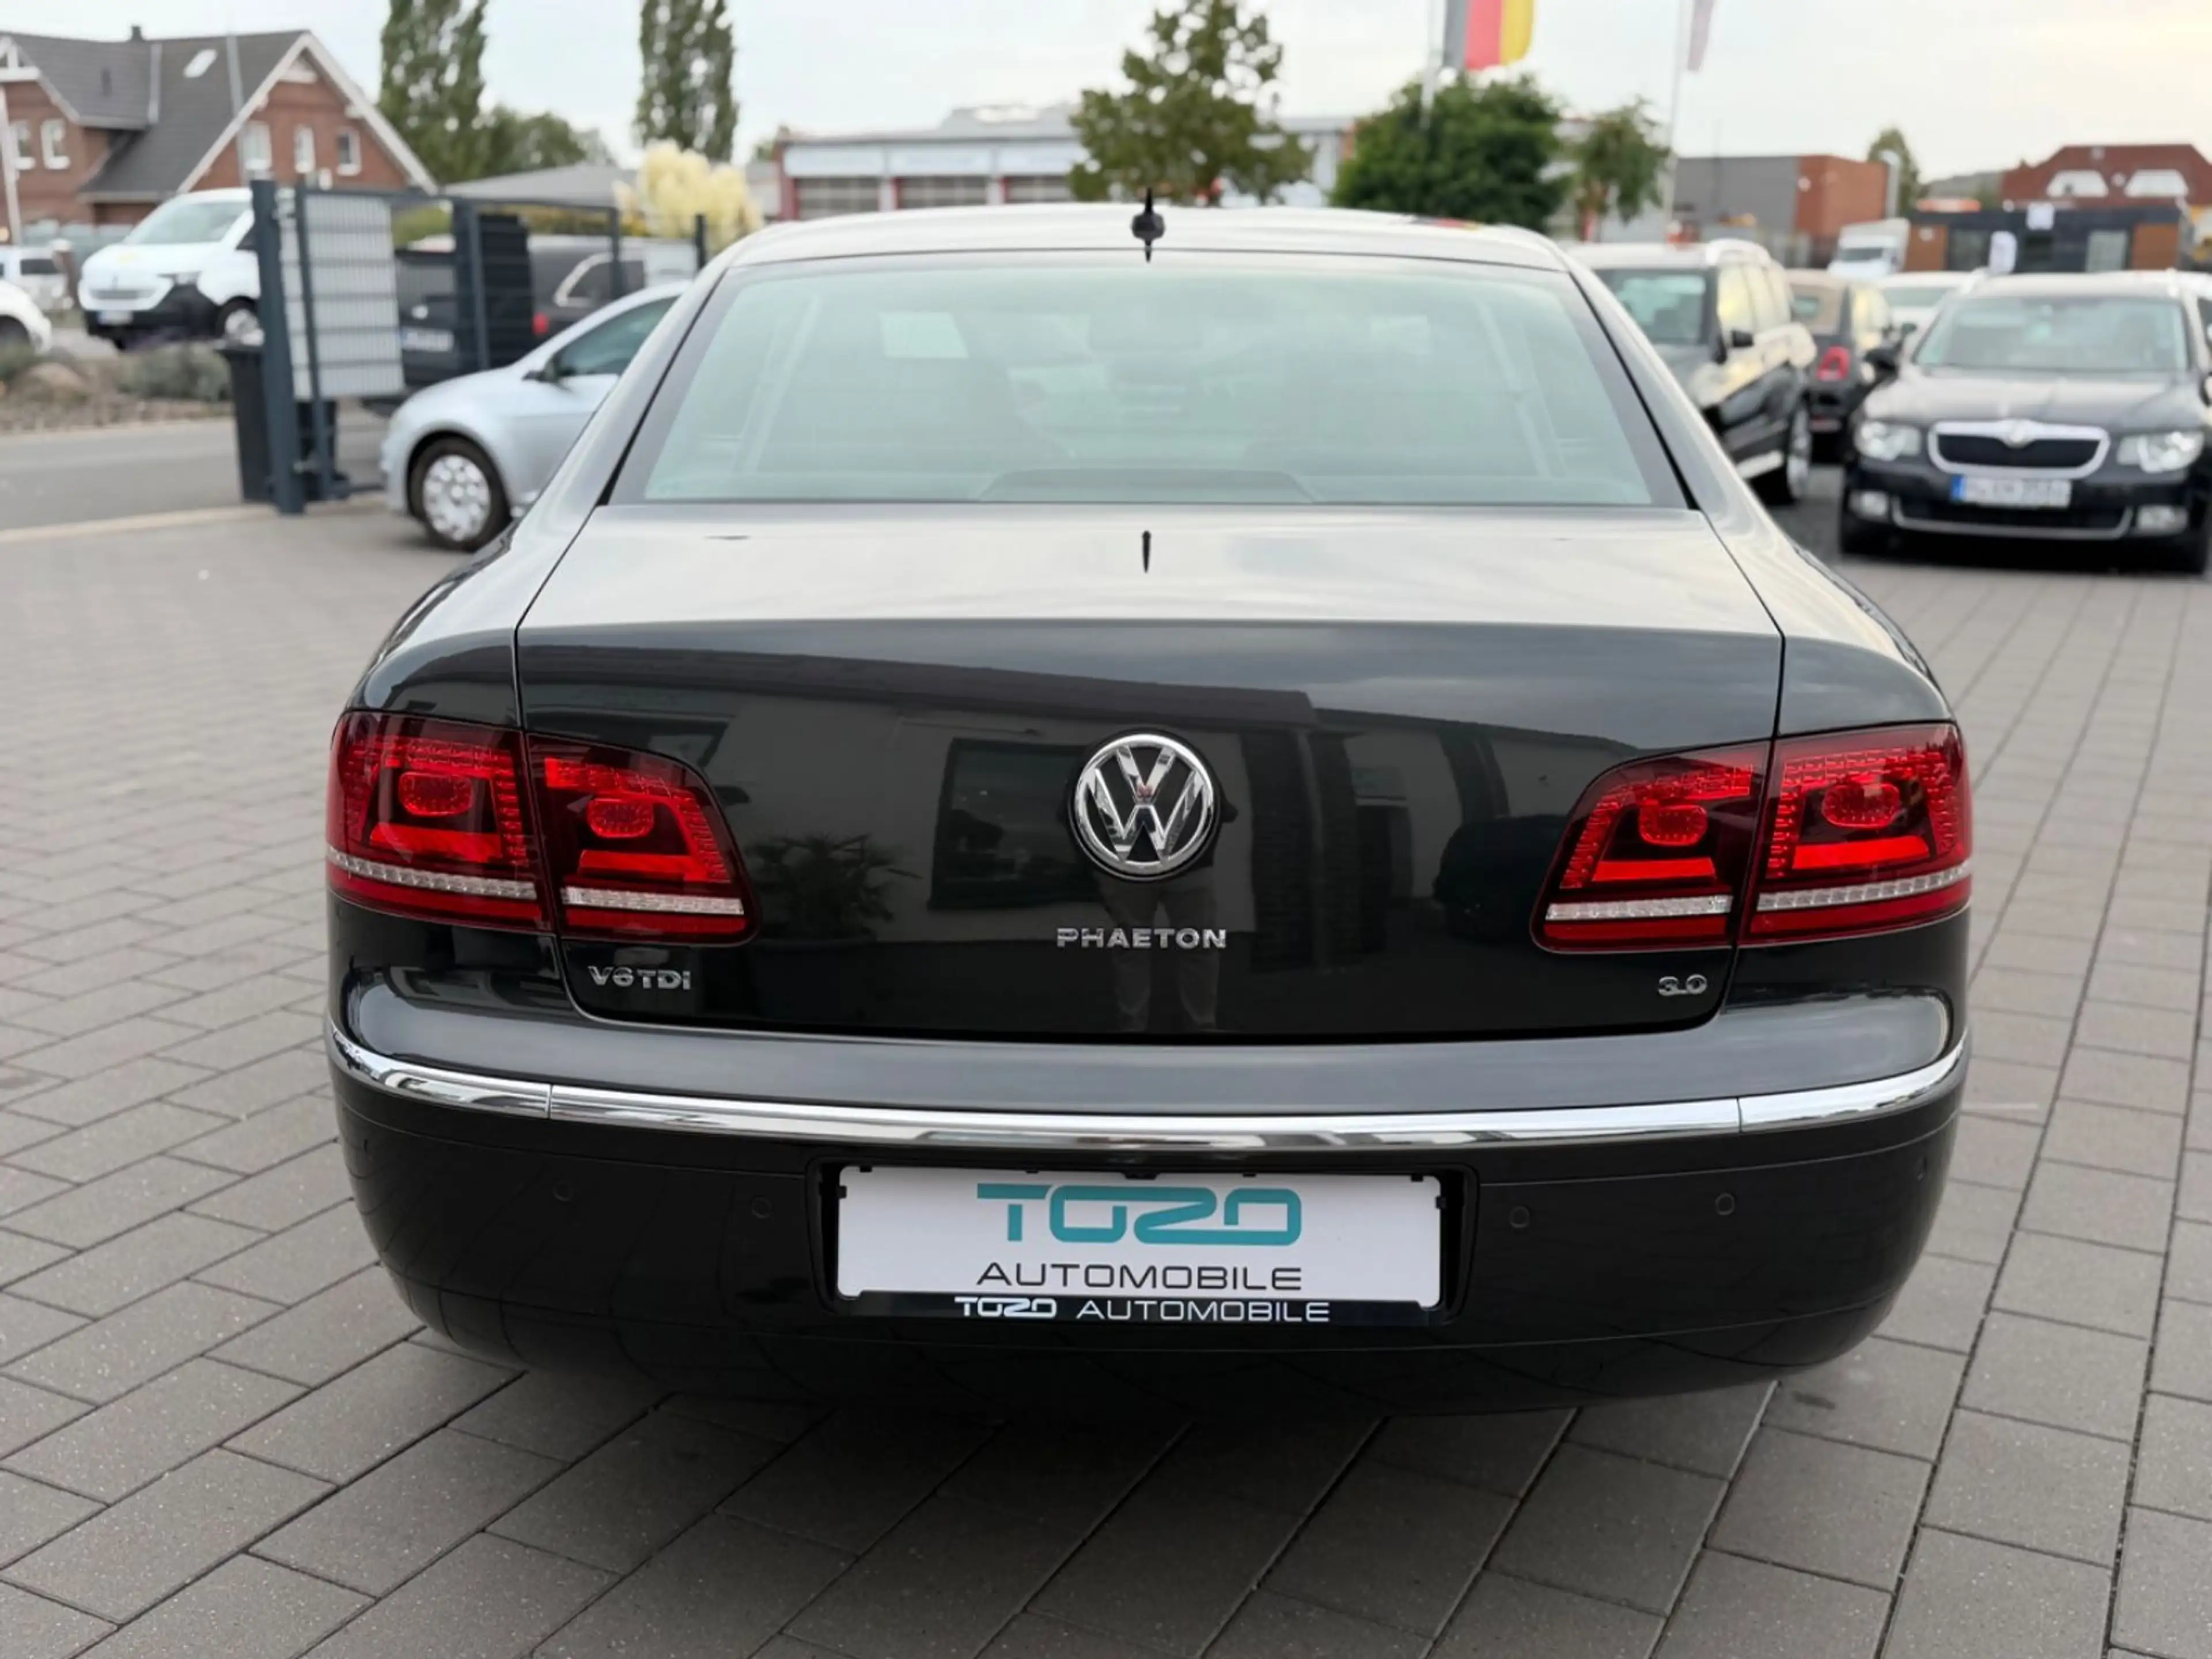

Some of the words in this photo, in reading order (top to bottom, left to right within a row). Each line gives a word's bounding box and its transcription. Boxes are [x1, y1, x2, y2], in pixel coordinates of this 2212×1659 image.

[1056, 927, 1228, 949] PHAETON
[1657, 973, 1708, 997] 3.0
[976, 1183, 1302, 1247] TOZO
[976, 1262, 1302, 1291] AUTOMOBILE
[954, 1296, 1058, 1317] TOZO
[1075, 1299, 1331, 1323] AUTOMOBILE
